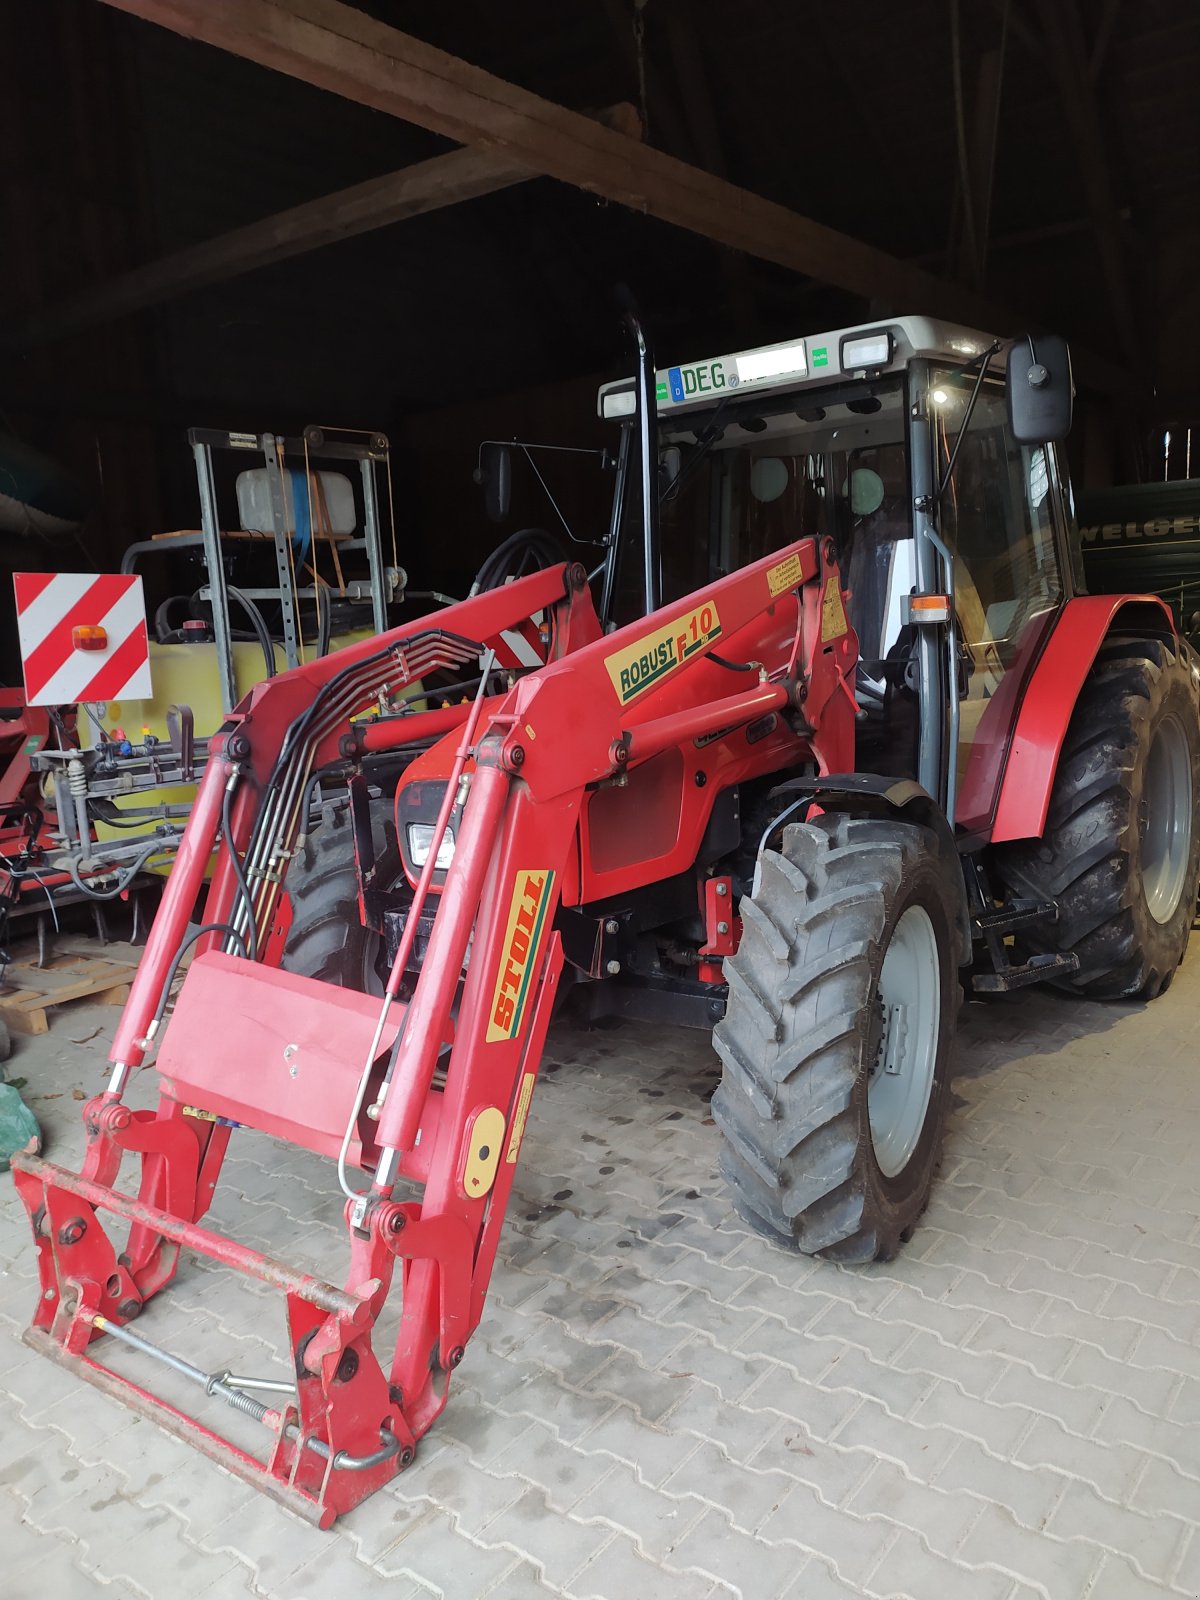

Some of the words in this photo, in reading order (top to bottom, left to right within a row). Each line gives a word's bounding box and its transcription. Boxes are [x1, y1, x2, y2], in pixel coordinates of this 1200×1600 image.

[682, 362, 726, 395] DEG
[1080, 516, 1200, 541] WELGE
[620, 637, 674, 692] ROBUST
[493, 875, 544, 1032] STOLL
